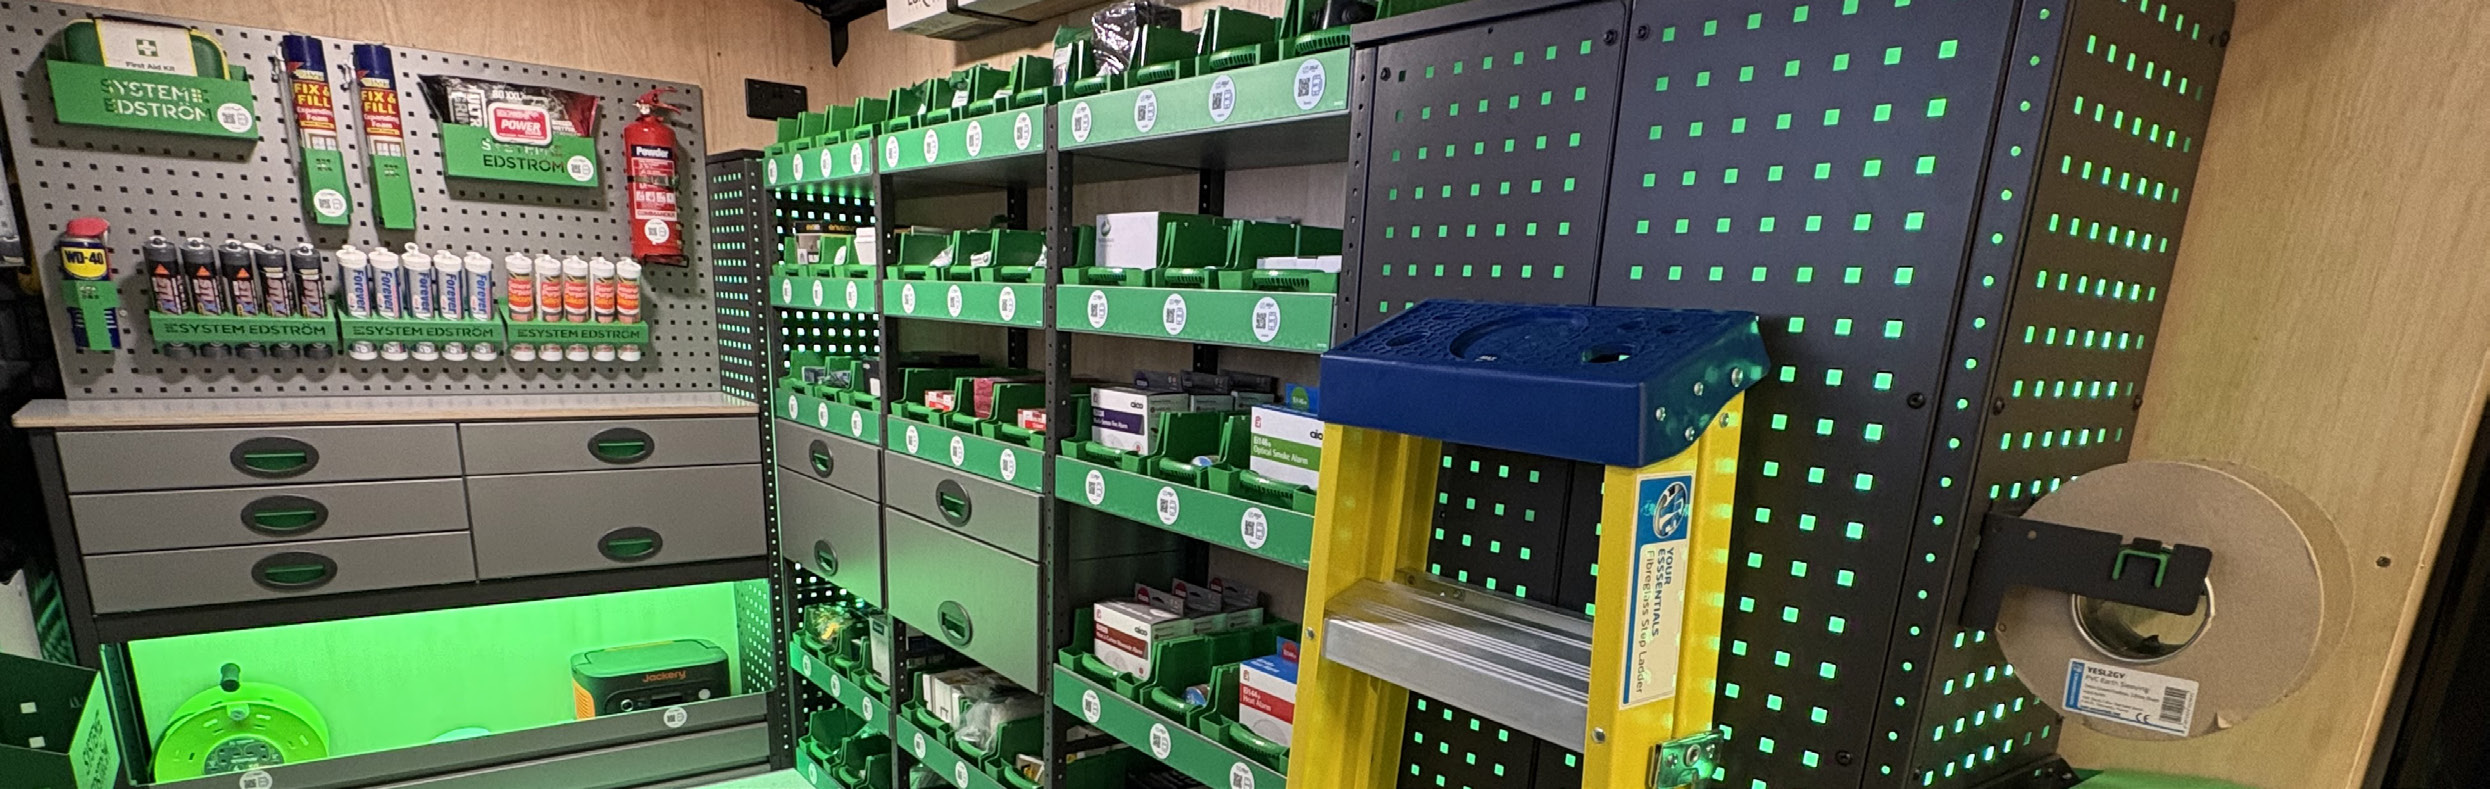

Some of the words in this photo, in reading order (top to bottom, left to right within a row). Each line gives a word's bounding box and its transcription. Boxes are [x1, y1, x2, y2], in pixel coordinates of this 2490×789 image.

[126, 61, 145, 69] First
[147, 63, 162, 71] Aid
[101, 78, 190, 101] SYSTEM
[294, 83, 320, 96] FIX
[322, 88, 331, 97] &
[297, 95, 331, 108] FILL
[361, 91, 385, 103] FIX
[386, 94, 397, 104] &
[364, 102, 397, 115] FILL
[467, 94, 482, 127] ULTR
[501, 118, 541, 132] POWER
[636, 146, 669, 158] Powder
[64, 250, 104, 265] WD-40
[353, 269, 366, 311] Forever
[381, 270, 394, 311] Forever
[418, 272, 430, 312] Forever
[445, 273, 457, 313] Forever
[476, 274, 488, 314] Forever
[180, 324, 246, 334] SYSTEM
[250, 322, 326, 336] EDSTRÖM
[365, 326, 423, 336] SYSTEM
[528, 329, 579, 338] SYSTEM
[1130, 400, 1144, 409] aico
[1309, 429, 1324, 440] aic
[1253, 444, 1272, 457] Optical
[1273, 448, 1291, 461] Smoke
[1291, 453, 1309, 465] Alarm
[1664, 547, 1675, 586] YOUR
[1642, 550, 1655, 616] Fibreglass
[1134, 625, 1148, 637] aico
[1639, 620, 1649, 647] Step
[642, 669, 687, 683] Jackery
[1636, 651, 1647, 693] Ladder
[2087, 666, 2126, 679] YESL2GY
[1256, 699, 1272, 712] Alarm
